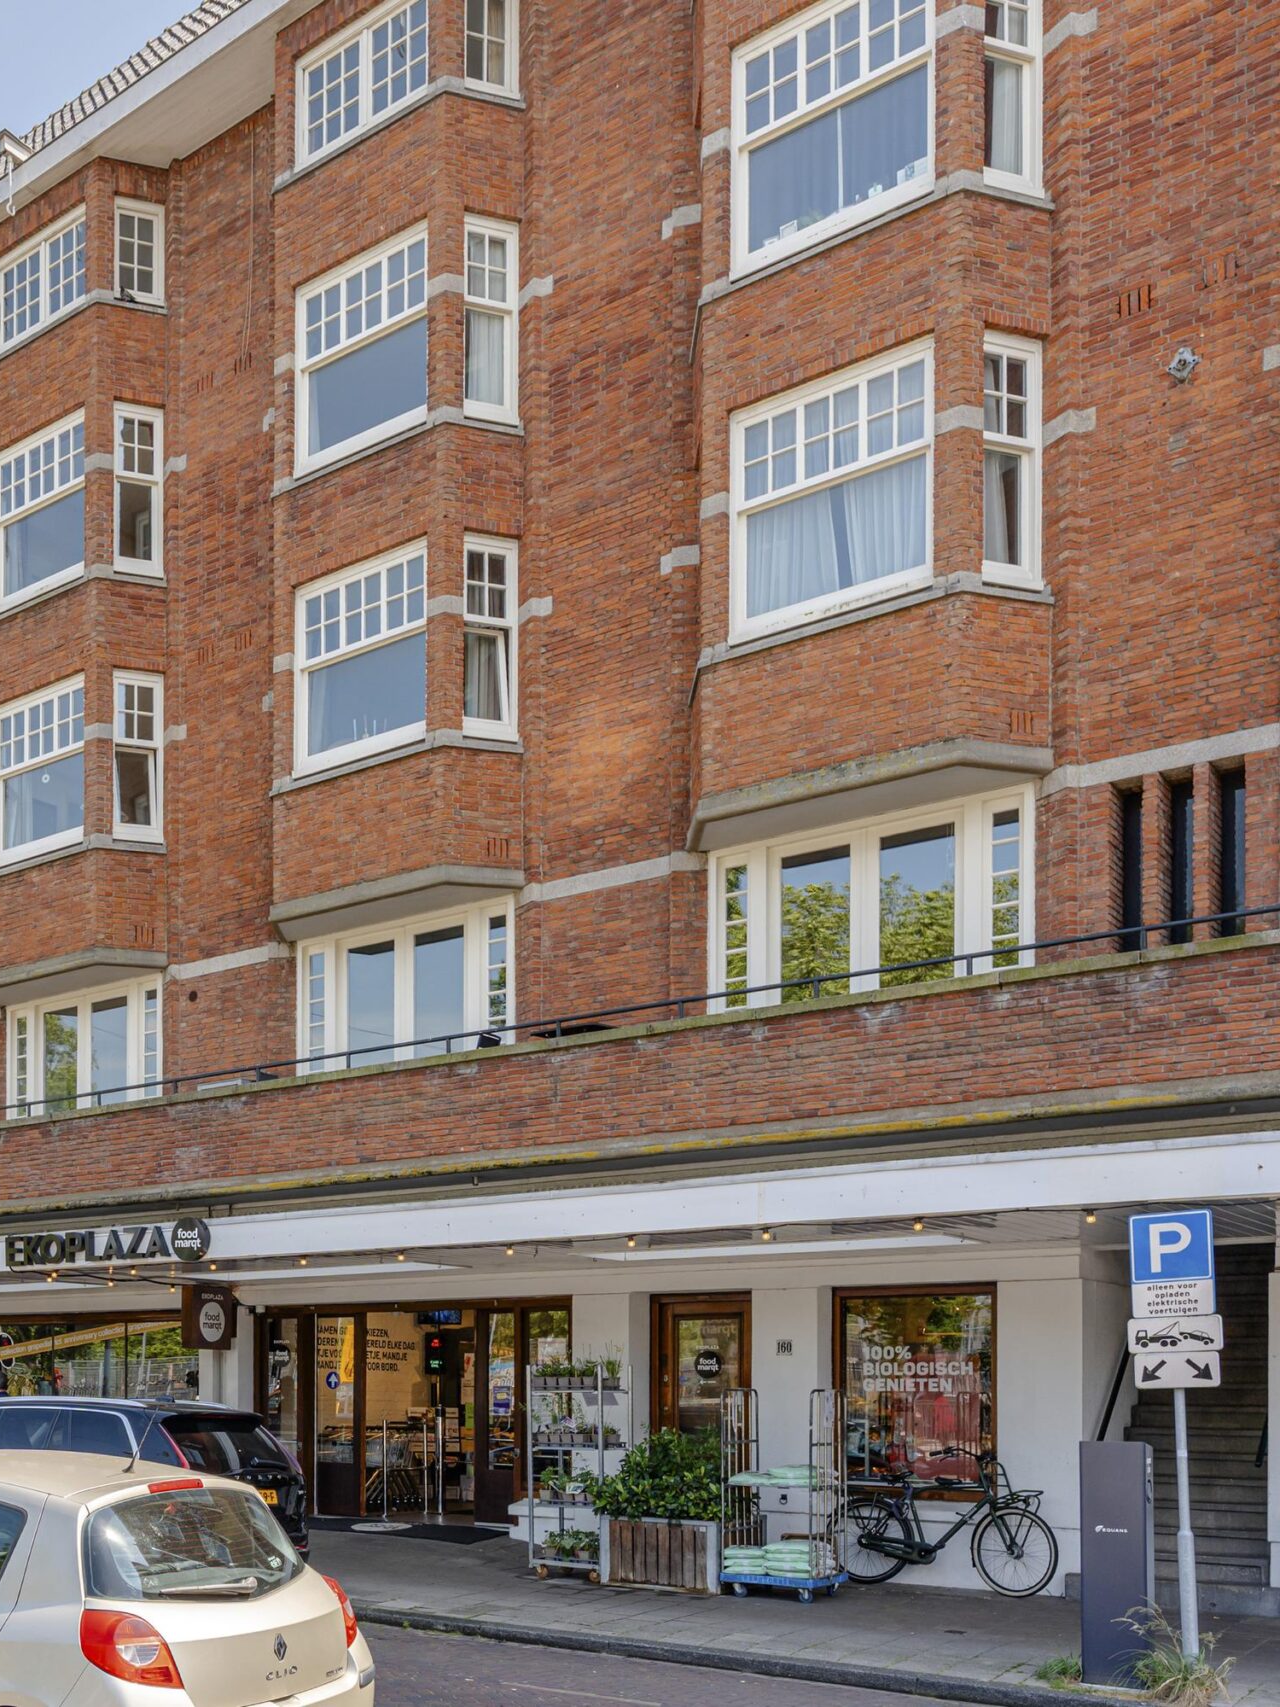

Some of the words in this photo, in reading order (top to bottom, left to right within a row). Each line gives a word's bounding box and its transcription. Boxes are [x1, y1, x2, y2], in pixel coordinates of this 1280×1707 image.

[177, 1228, 198, 1239] food
[5, 1226, 171, 1267] EKOPLAZA
[174, 1238, 201, 1250] marqt
[1149, 1222, 1192, 1273] P
[1147, 1284, 1174, 1292] alleen
[1155, 1291, 1191, 1299] opladen
[1147, 1298, 1199, 1307] elektrische
[205, 1311, 220, 1321] food
[1148, 1306, 1198, 1315] voertuigen
[97, 1325, 125, 1337] collectio
[202, 1322, 222, 1331] marqt
[777, 1340, 793, 1354] 160
[862, 1345, 912, 1360] 100%
[382, 1352, 408, 1361] MANDJE
[700, 1357, 717, 1365] food
[697, 1364, 719, 1372] marqt
[862, 1361, 974, 1376] BIOLOGISCH
[862, 1378, 953, 1393] GENIETEN
[265, 1665, 298, 1681] CLIO
